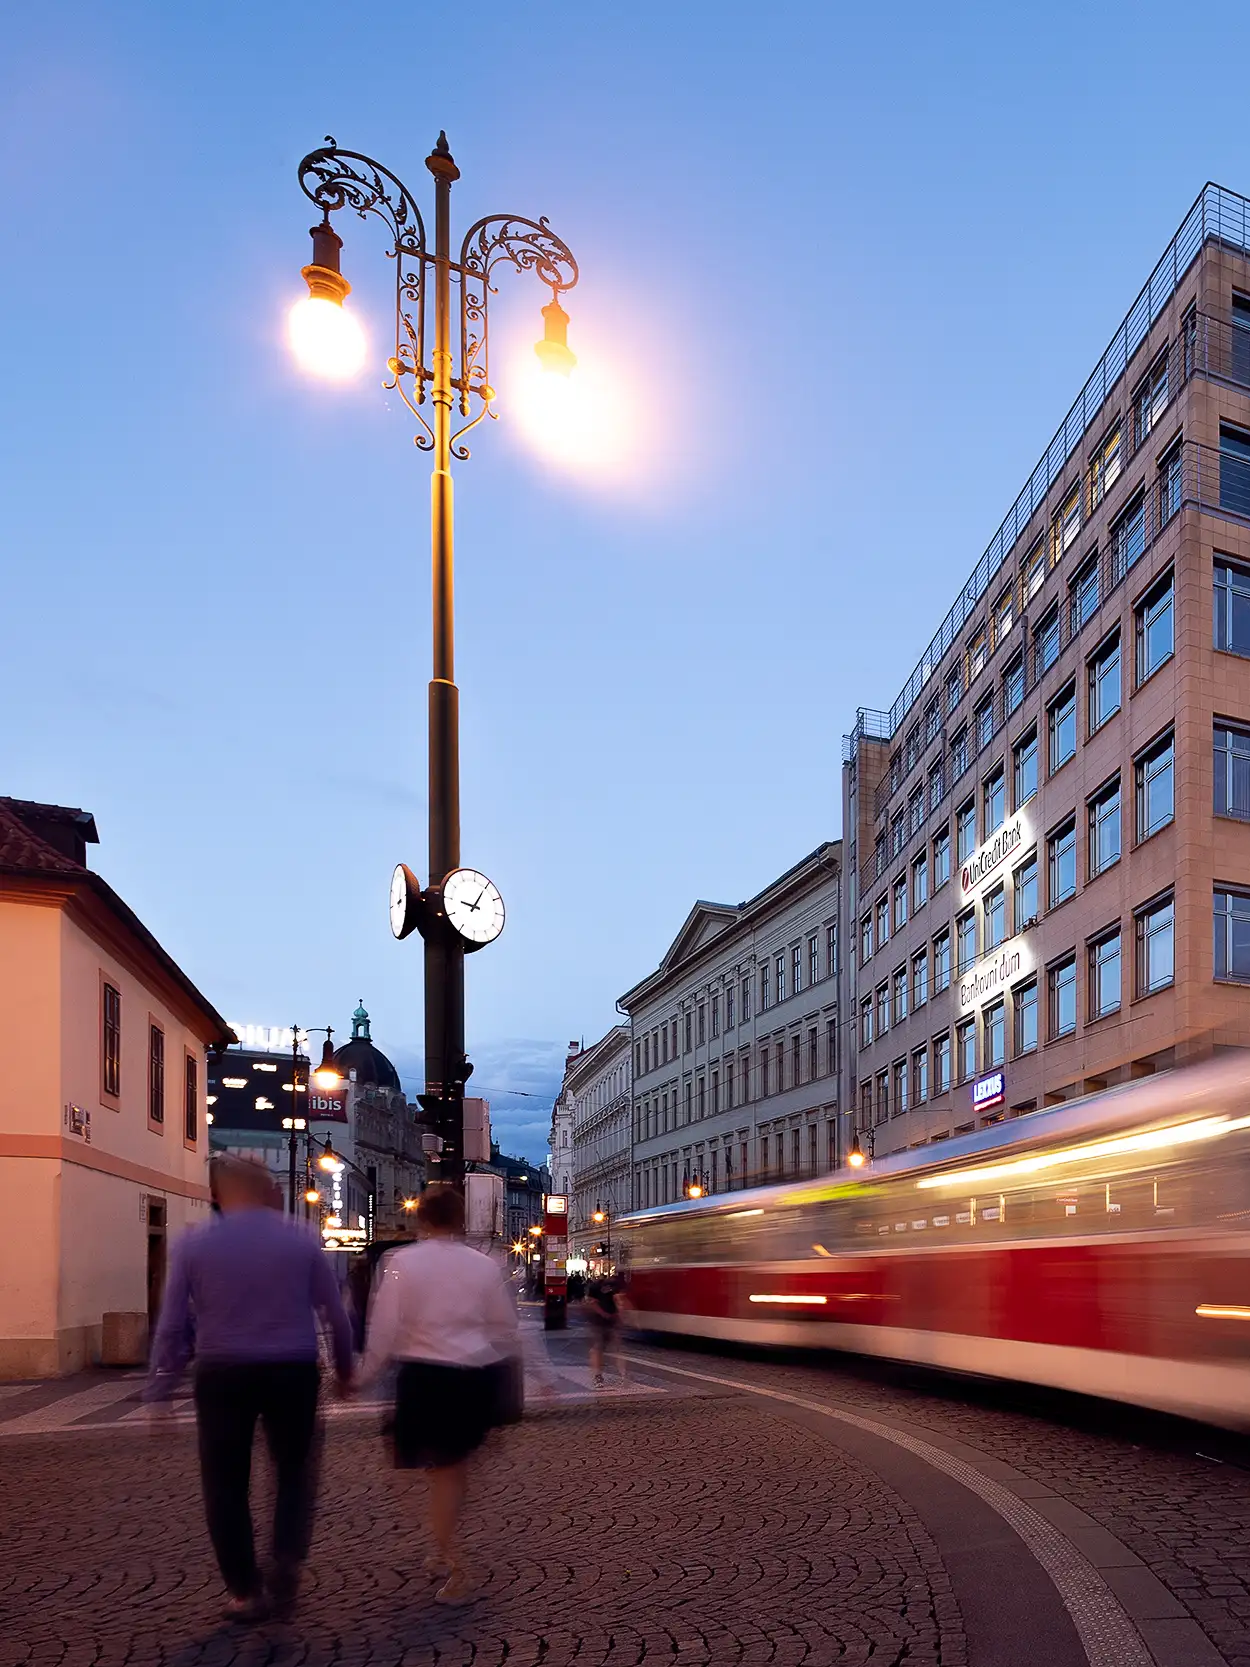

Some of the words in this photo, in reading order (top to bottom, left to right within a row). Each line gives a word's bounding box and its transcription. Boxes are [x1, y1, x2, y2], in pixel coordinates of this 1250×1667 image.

[969, 838, 1001, 885] UniCredit
[1002, 820, 1021, 854] Bank
[312, 1096, 342, 1111] ibis
